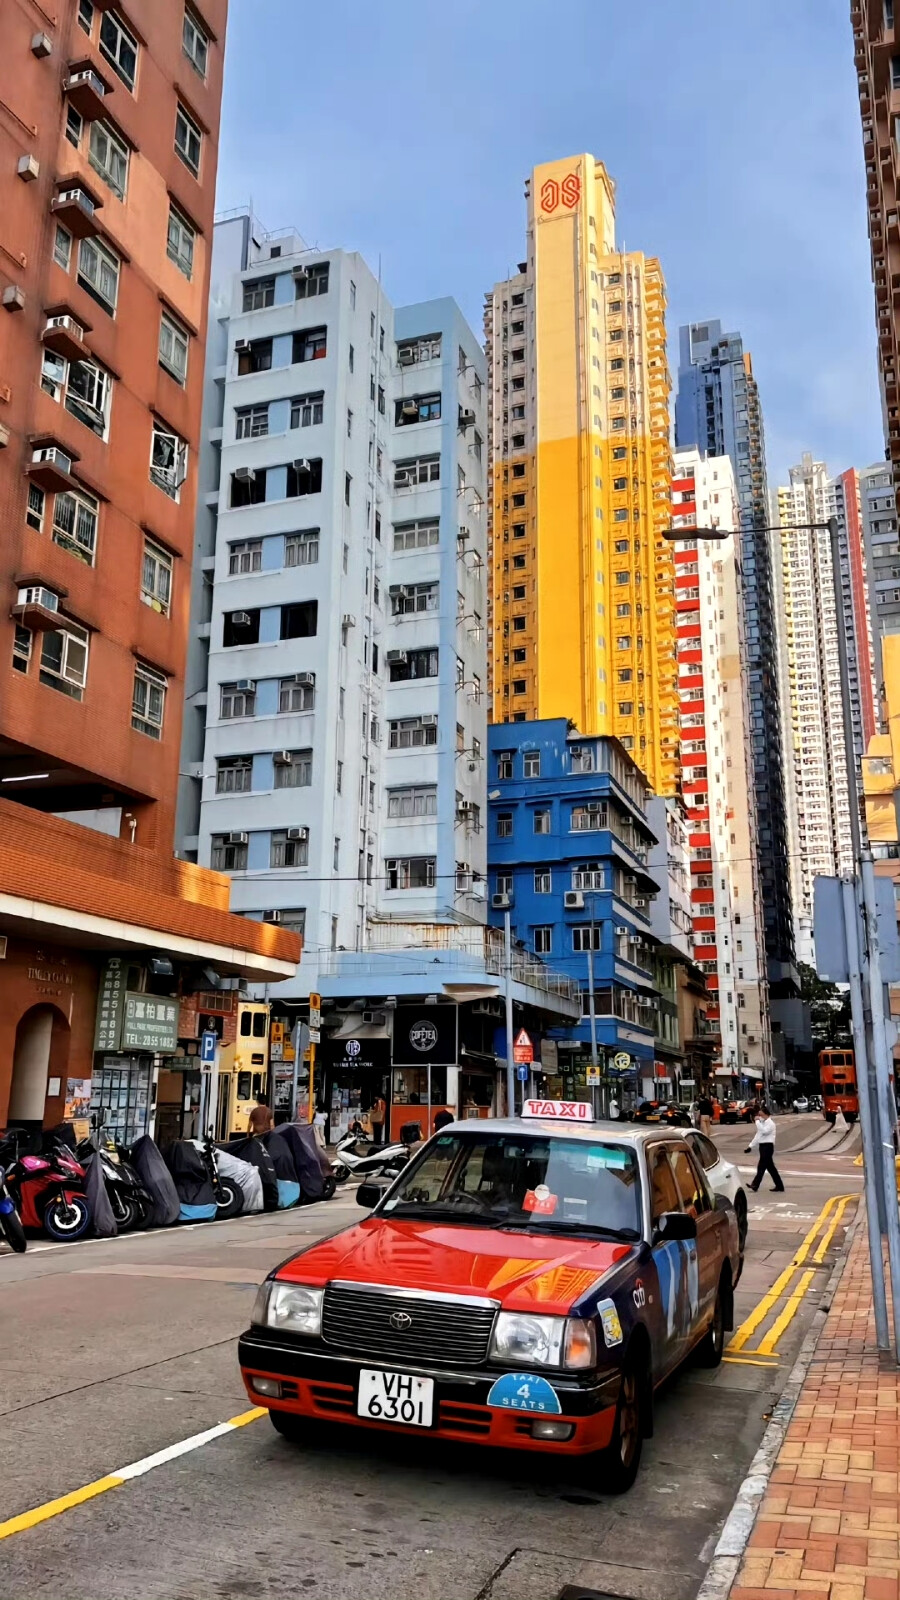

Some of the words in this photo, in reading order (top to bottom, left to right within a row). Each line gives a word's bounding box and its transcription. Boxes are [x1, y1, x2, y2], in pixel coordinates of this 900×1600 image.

[142, 1035, 158, 1046] 2855
[159, 1037, 174, 1048] 1882
[204, 1037, 213, 1059] P
[528, 1100, 586, 1118] TAXI
[382, 1373, 413, 1399] VH
[516, 1384, 531, 1399] 4
[367, 1394, 423, 1424] 6301
[502, 1397, 546, 1411] SEATS
